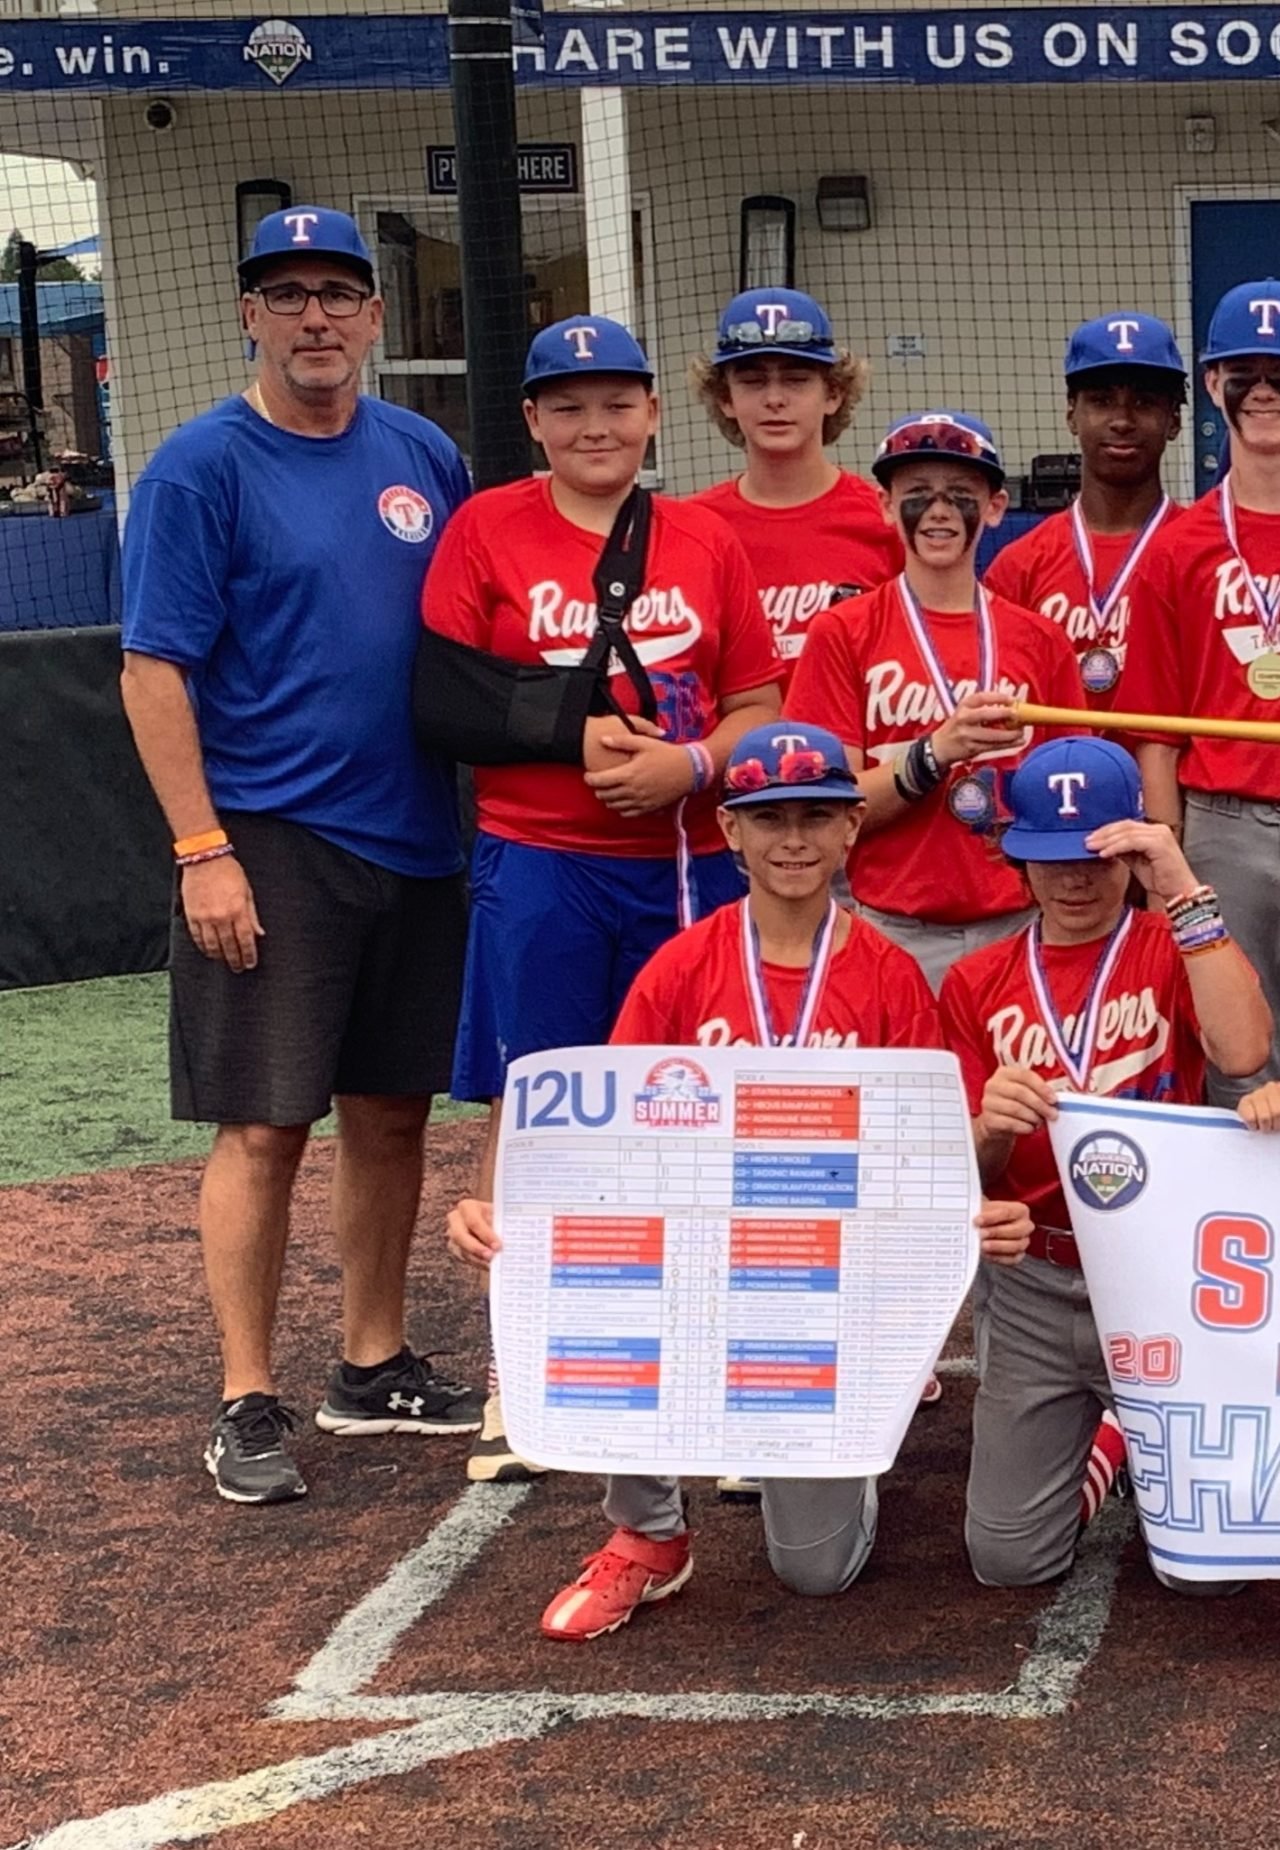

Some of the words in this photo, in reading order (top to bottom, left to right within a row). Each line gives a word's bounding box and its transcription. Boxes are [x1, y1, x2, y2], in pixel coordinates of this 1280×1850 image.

[55, 36, 170, 75] win.
[243, 42, 311, 62] NATION
[512, 27, 691, 72] HARE
[716, 26, 893, 70] WITH
[926, 22, 1013, 68] US
[1042, 20, 1138, 67] ON
[518, 156, 566, 181] HERE
[284, 213, 318, 242] T
[756, 304, 788, 335] T
[564, 327, 598, 359] T
[1108, 320, 1139, 351] T
[1048, 772, 1086, 816] T
[513, 1069, 616, 1130] 12U
[635, 1102, 719, 1121] SUMMER
[1072, 1162, 1145, 1183] NATION
[1106, 1332, 1182, 1388] 20
